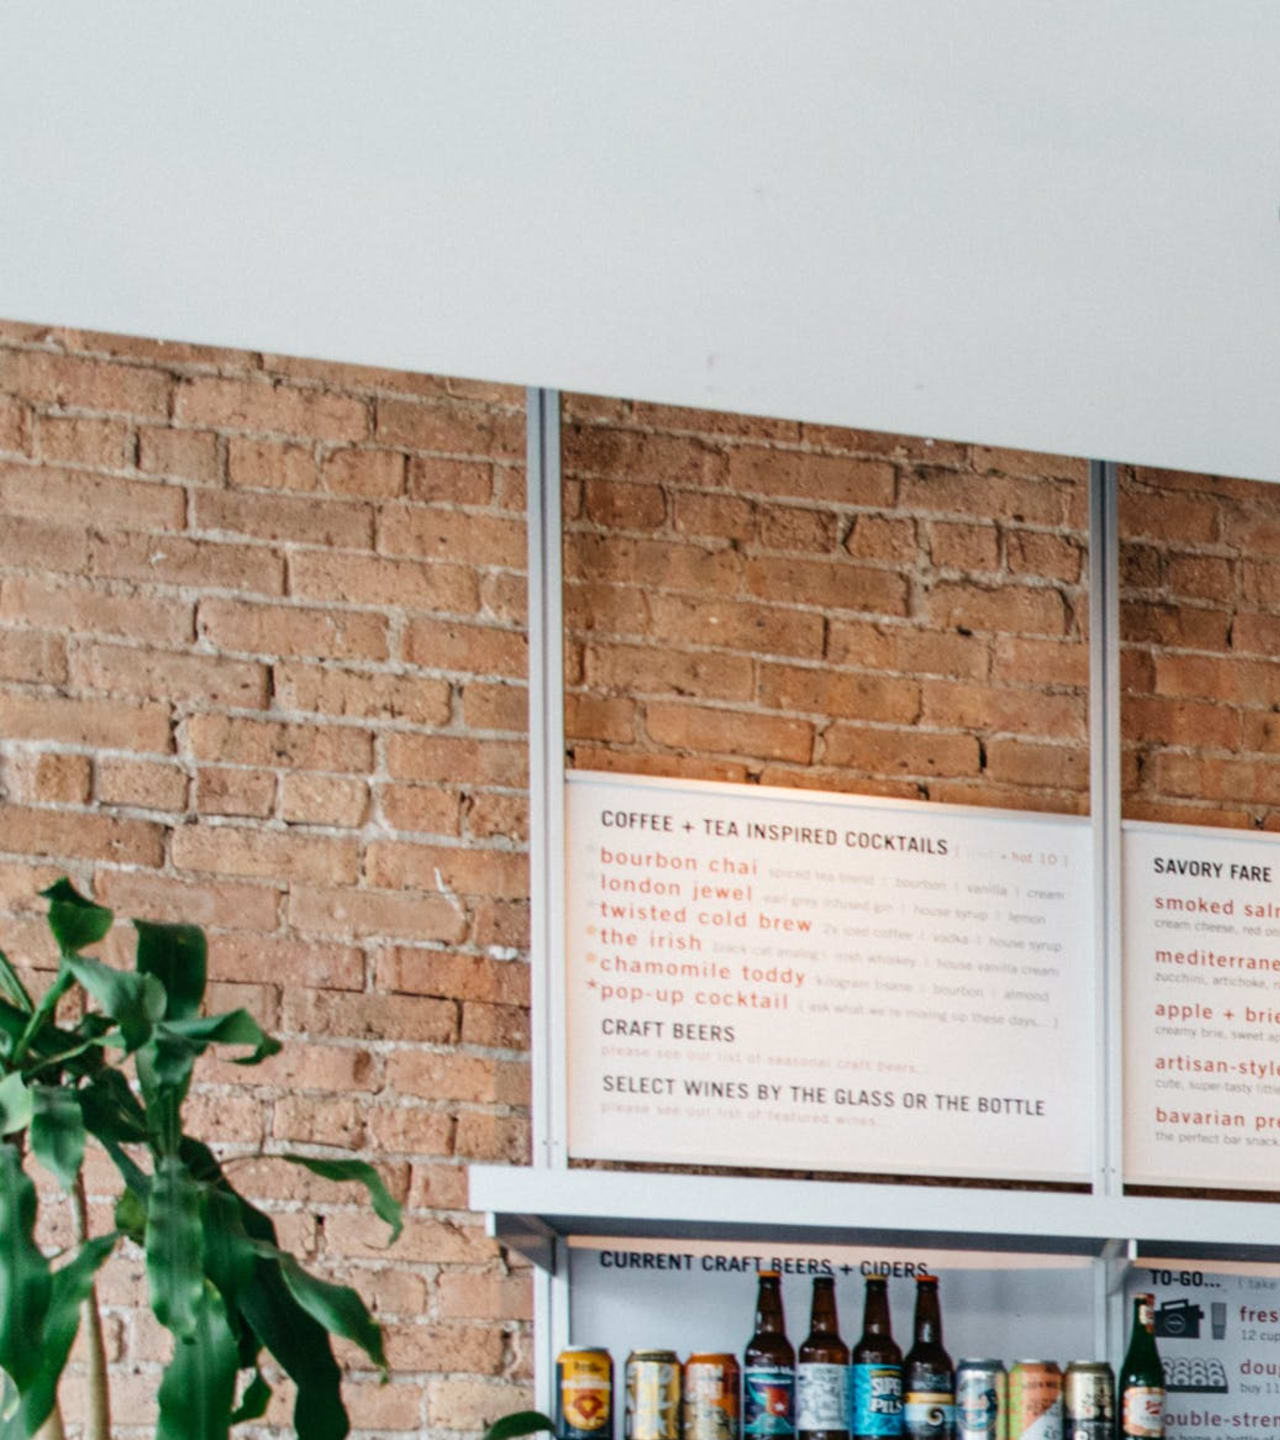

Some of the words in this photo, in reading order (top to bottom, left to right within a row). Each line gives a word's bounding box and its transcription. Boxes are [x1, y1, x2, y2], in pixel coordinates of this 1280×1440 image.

[600, 809, 673, 833] COFFEE
[703, 818, 739, 837] TEA
[747, 823, 838, 846] INSPIRED
[845, 831, 949, 856] COCKTAILS
[599, 847, 699, 870] bourbon
[708, 856, 758, 876] chai
[1153, 857, 1223, 878] SAVORY
[1230, 863, 1272, 883] FARE
[601, 874, 681, 897] london
[692, 885, 753, 902] jewel
[600, 900, 688, 923] twisted
[697, 911, 748, 929] cold
[757, 912, 812, 933] brew
[1155, 897, 1234, 916] smoked
[599, 928, 637, 947] the
[650, 935, 703, 951] irish
[599, 955, 731, 980] chamomile
[741, 965, 806, 988] toddy
[695, 991, 789, 1009] cocktail
[1154, 1003, 1213, 1022] apple
[601, 1018, 664, 1038] CRAFT
[672, 1022, 735, 1043] BEERS
[602, 1074, 675, 1095] SELECT
[683, 1080, 749, 1100] WINES
[757, 1083, 782, 1101] BY
[789, 1085, 826, 1104] THE
[834, 1088, 895, 1108] GLASS
[902, 1092, 927, 1110] OR
[934, 1093, 969, 1112] THE
[977, 1096, 1045, 1117] BOTTLE
[1155, 1106, 1246, 1127] bavarian
[599, 1250, 694, 1271] CURRENT
[700, 1254, 762, 1274] CRAFT
[771, 1257, 832, 1277] BEERS
[859, 1259, 929, 1279] CIDERS
